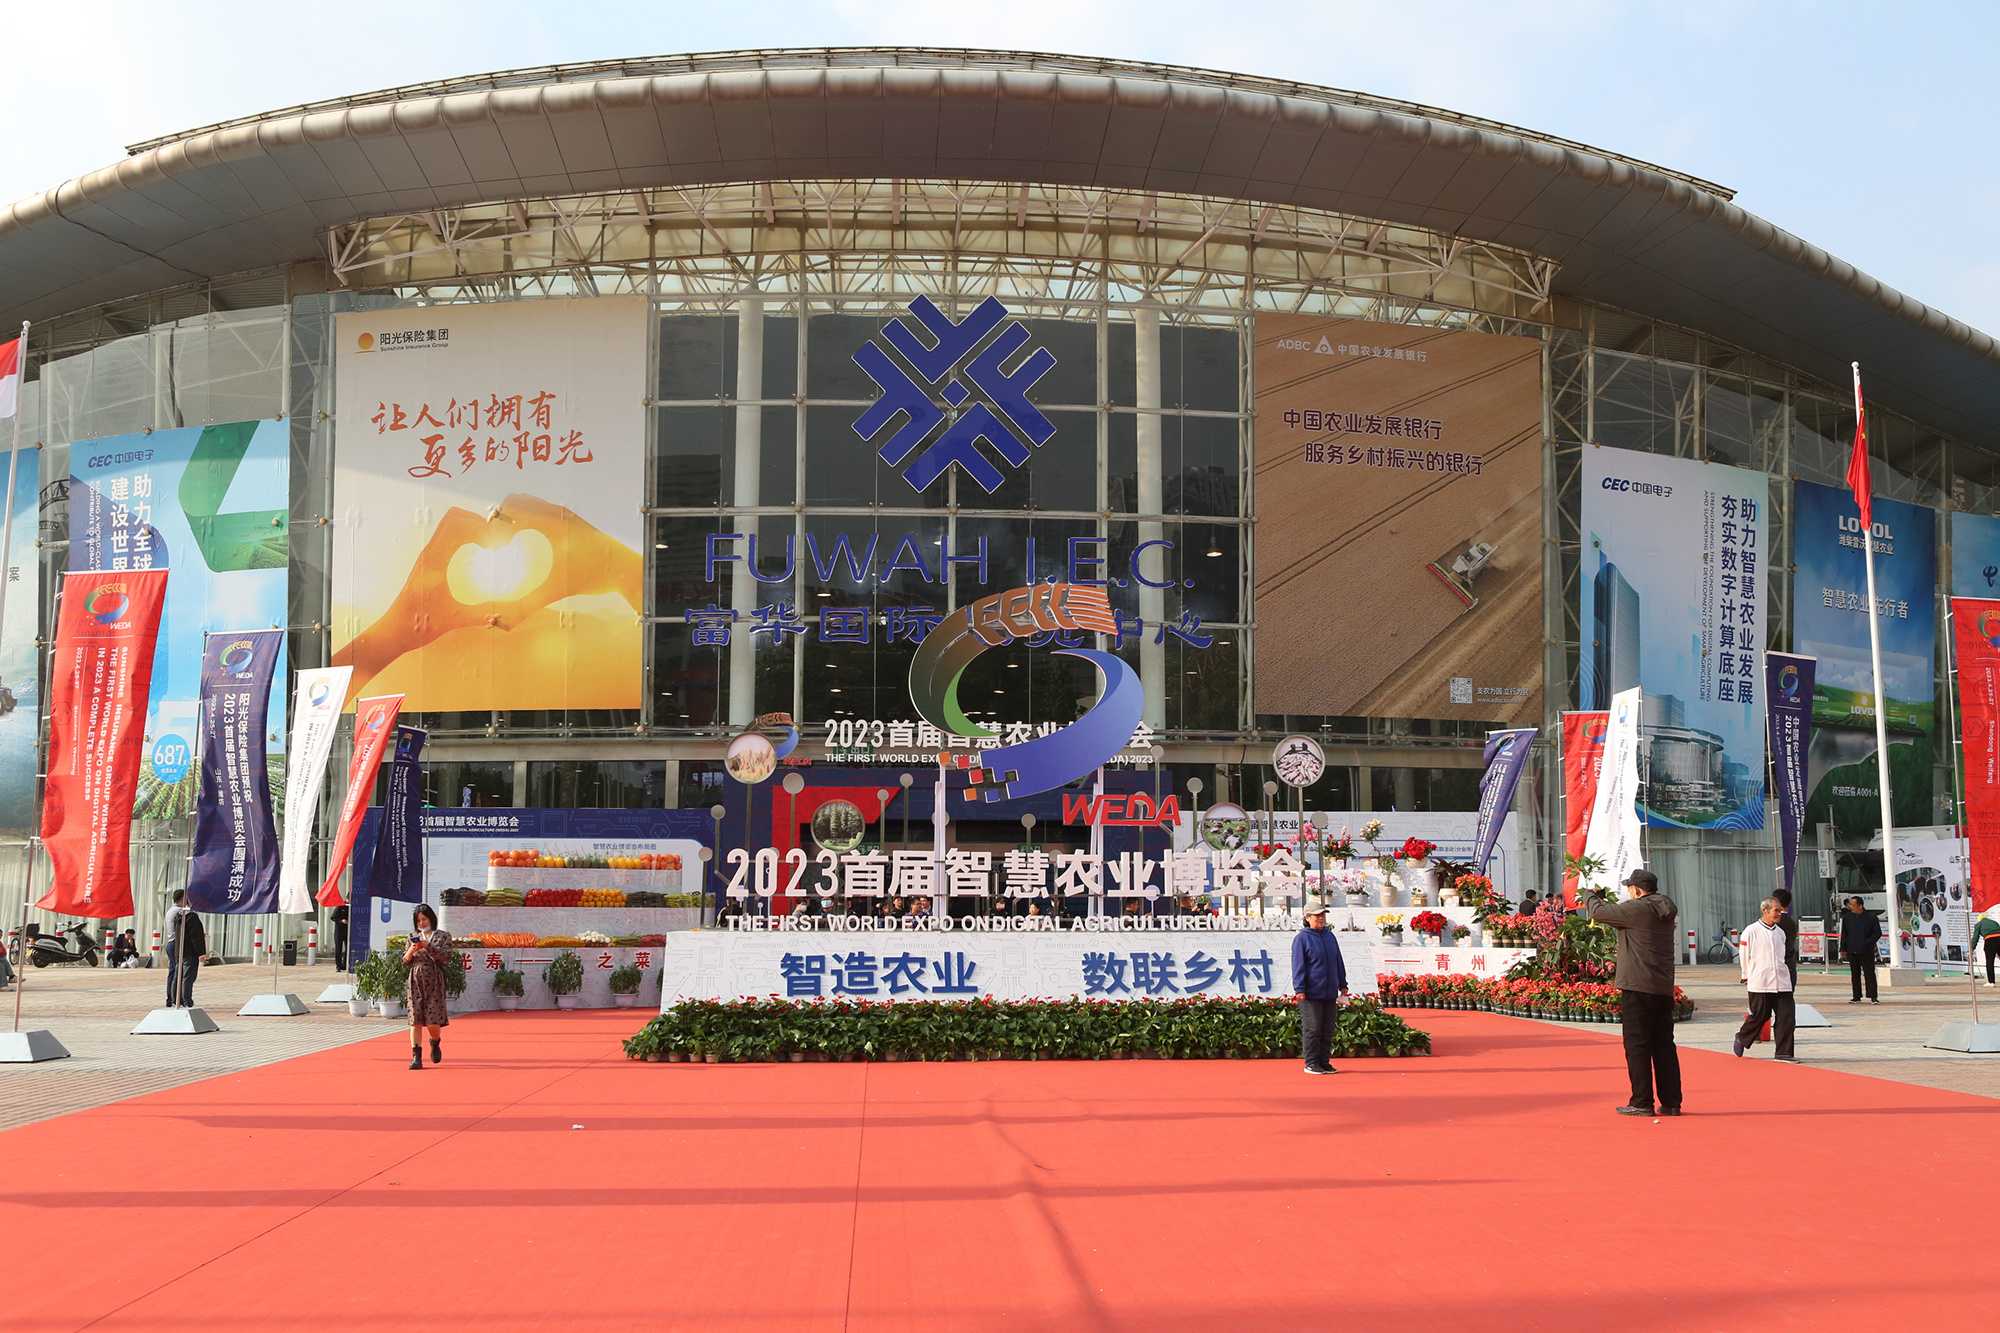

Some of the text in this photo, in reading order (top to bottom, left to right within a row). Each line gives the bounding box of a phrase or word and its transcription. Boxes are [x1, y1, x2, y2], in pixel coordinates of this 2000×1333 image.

[380, 329, 448, 345] 阳光保险集团
[1277, 339, 1311, 351] ADBC
[1337, 343, 1428, 362] 中国农业发展银行
[371, 390, 556, 434] 让人们拥有
[1284, 409, 1443, 440] 中国农业发展银行
[88, 454, 113, 468] CEC
[114, 449, 154, 464] 中国电子
[407, 429, 594, 479] 更多的阳光
[1305, 443, 1483, 475] 服务乡村振兴的银行
[1601, 476, 1630, 492] CEC
[1631, 482, 1673, 498] 中国电子
[705, 533, 1197, 589] FUWAH I.E.C.
[1717, 494, 1738, 702] 夯实数字计算底座
[1737, 498, 1757, 705] 助力智慧农业发展
[97, 647, 106, 658] IN
[95, 661, 104, 684] 2023
[86, 697, 99, 751] COMPLETE
[238, 693, 253, 803] 阳光保险集团预祝
[825, 753, 847, 765] THE
[848, 753, 876, 765] FIRST
[880, 753, 919, 765] WORLD
[84, 647, 118, 904] THE FIRST WORLD EXPO ON DIGITAL AGRICULTURE
[104, 765, 113, 801] GROUP
[223, 693, 246, 903] 2023首届智慧农业博览会圆满成功
[1062, 793, 1182, 827] WEDA
[99, 804, 110, 844] WISHES
[725, 847, 1304, 899] 2023首届智慧农业博览会
[725, 914, 767, 931] THE
[767, 914, 822, 931] FIRST
[827, 914, 897, 931] WORLD
[901, 914, 953, 931] EXPO
[961, 914, 989, 931] ON
[993, 914, 1065, 932] DIGITAL
[1071, 915, 1207, 932] AGRICULTURE
[780, 951, 979, 997] 智造农业
[1081, 949, 1274, 995] 数联乡村
